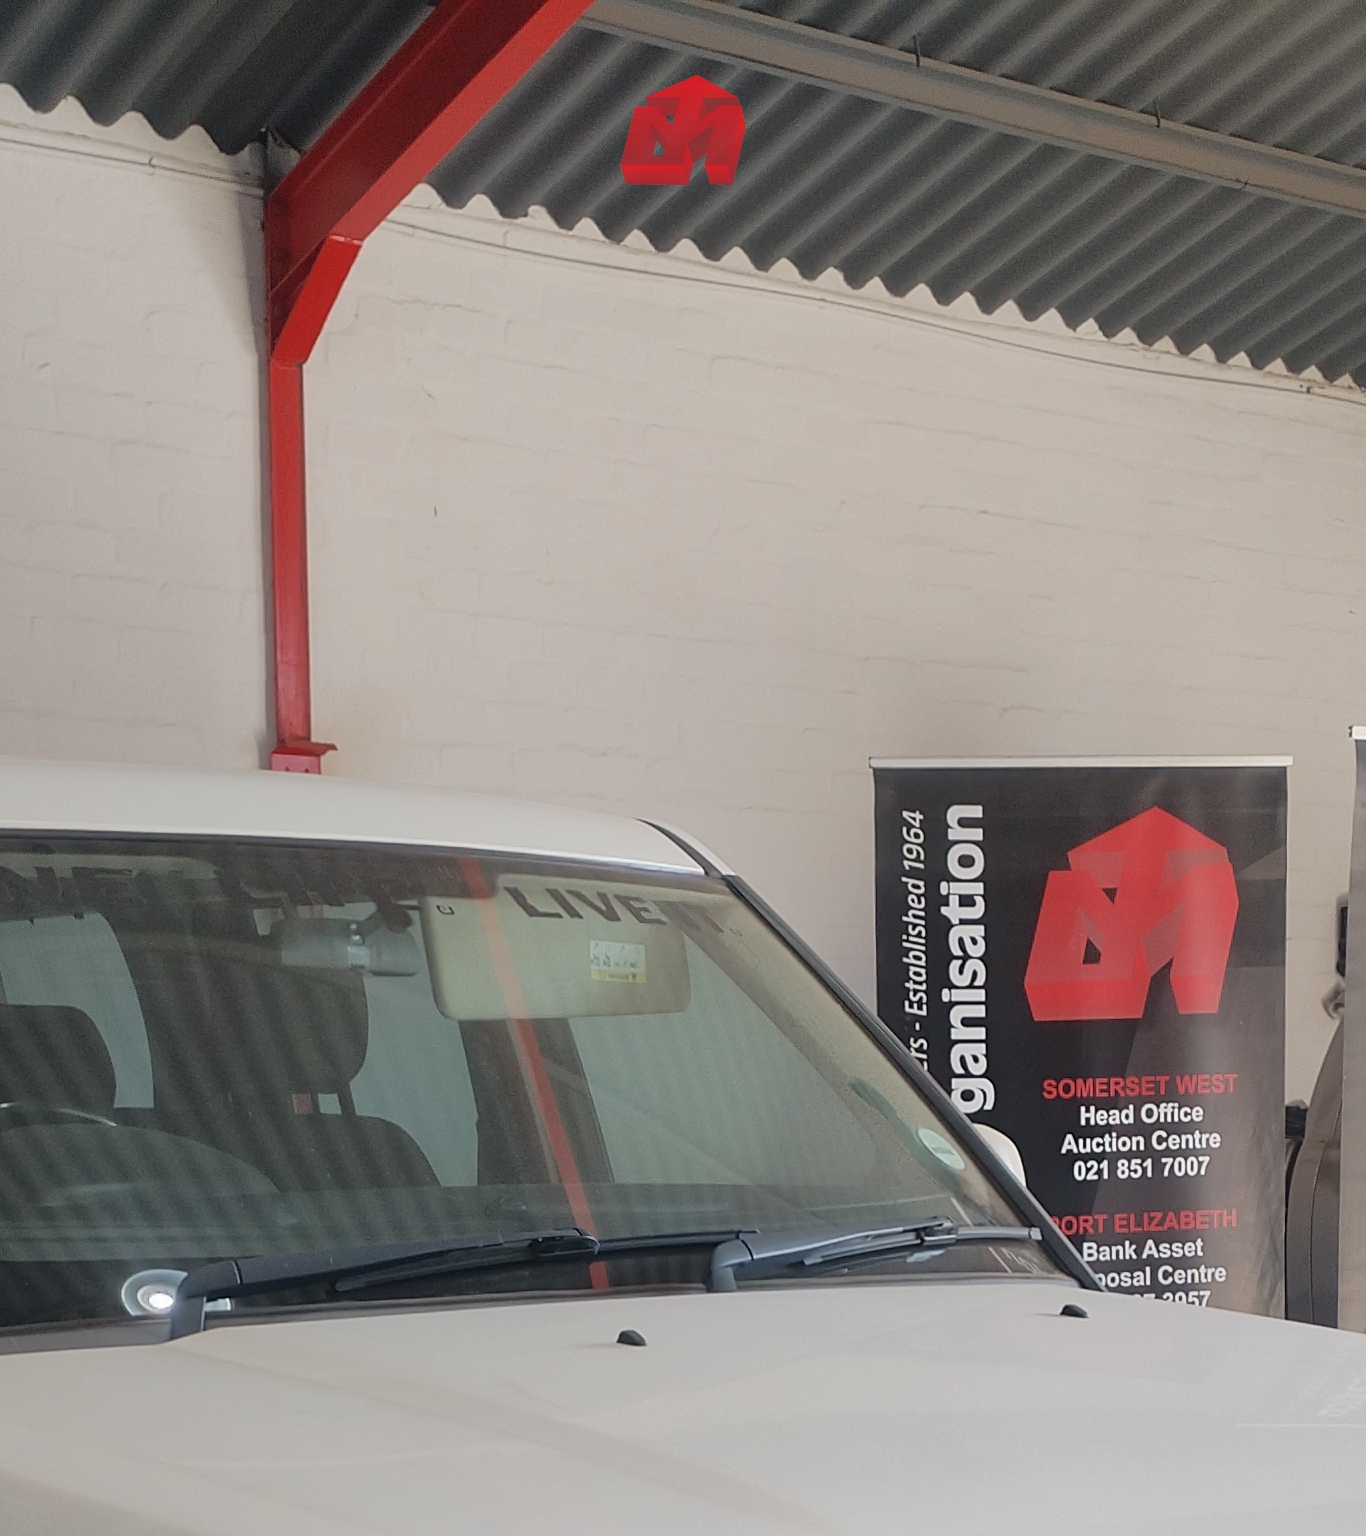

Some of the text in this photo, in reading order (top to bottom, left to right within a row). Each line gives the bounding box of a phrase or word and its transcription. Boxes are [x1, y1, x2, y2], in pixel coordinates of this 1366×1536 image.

[901, 809, 925, 871] 1964
[503, 885, 667, 925] LIVE
[901, 876, 928, 1018] Established
[940, 803, 995, 1114] ganisation
[1041, 1073, 1238, 1100] SOMERSET WEST
[1079, 1103, 1204, 1126] Head Office
[1060, 1130, 1222, 1154] Auction Centre
[1073, 1156, 1211, 1181] 021 851 7007
[1114, 1209, 1238, 1234] ELIZABETH
[1083, 1238, 1204, 1262] Bank Asset
[1158, 1264, 1227, 1285] Centre
